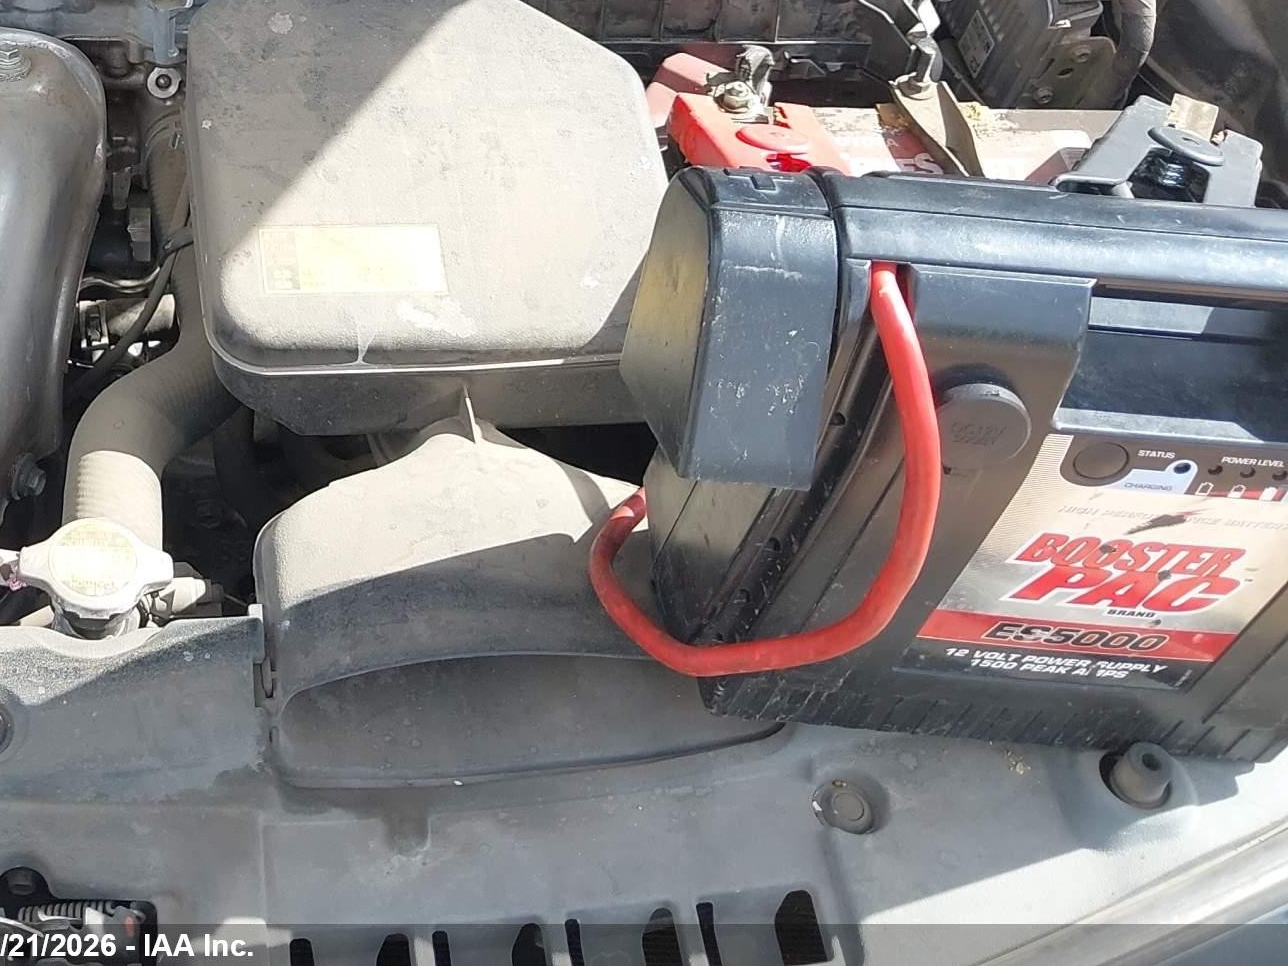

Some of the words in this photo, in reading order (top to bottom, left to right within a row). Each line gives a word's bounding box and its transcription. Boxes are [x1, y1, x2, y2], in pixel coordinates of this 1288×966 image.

[1137, 449, 1176, 460] STATUS
[1221, 456, 1258, 466] POWER
[1257, 459, 1286, 468] LEVEL
[1124, 482, 1173, 492] CHARGING
[1015, 532, 1247, 578] BOOSTER
[1010, 565, 1242, 613] PAC
[1107, 609, 1156, 619] BRAND
[981, 621, 1170, 651] ES5000
[945, 648, 969, 657] 12
[974, 650, 1020, 663] VOLT
[1022, 655, 1095, 668] POWER
[970, 659, 1017, 670] 1500
[1021, 663, 1069, 675] PEAK
